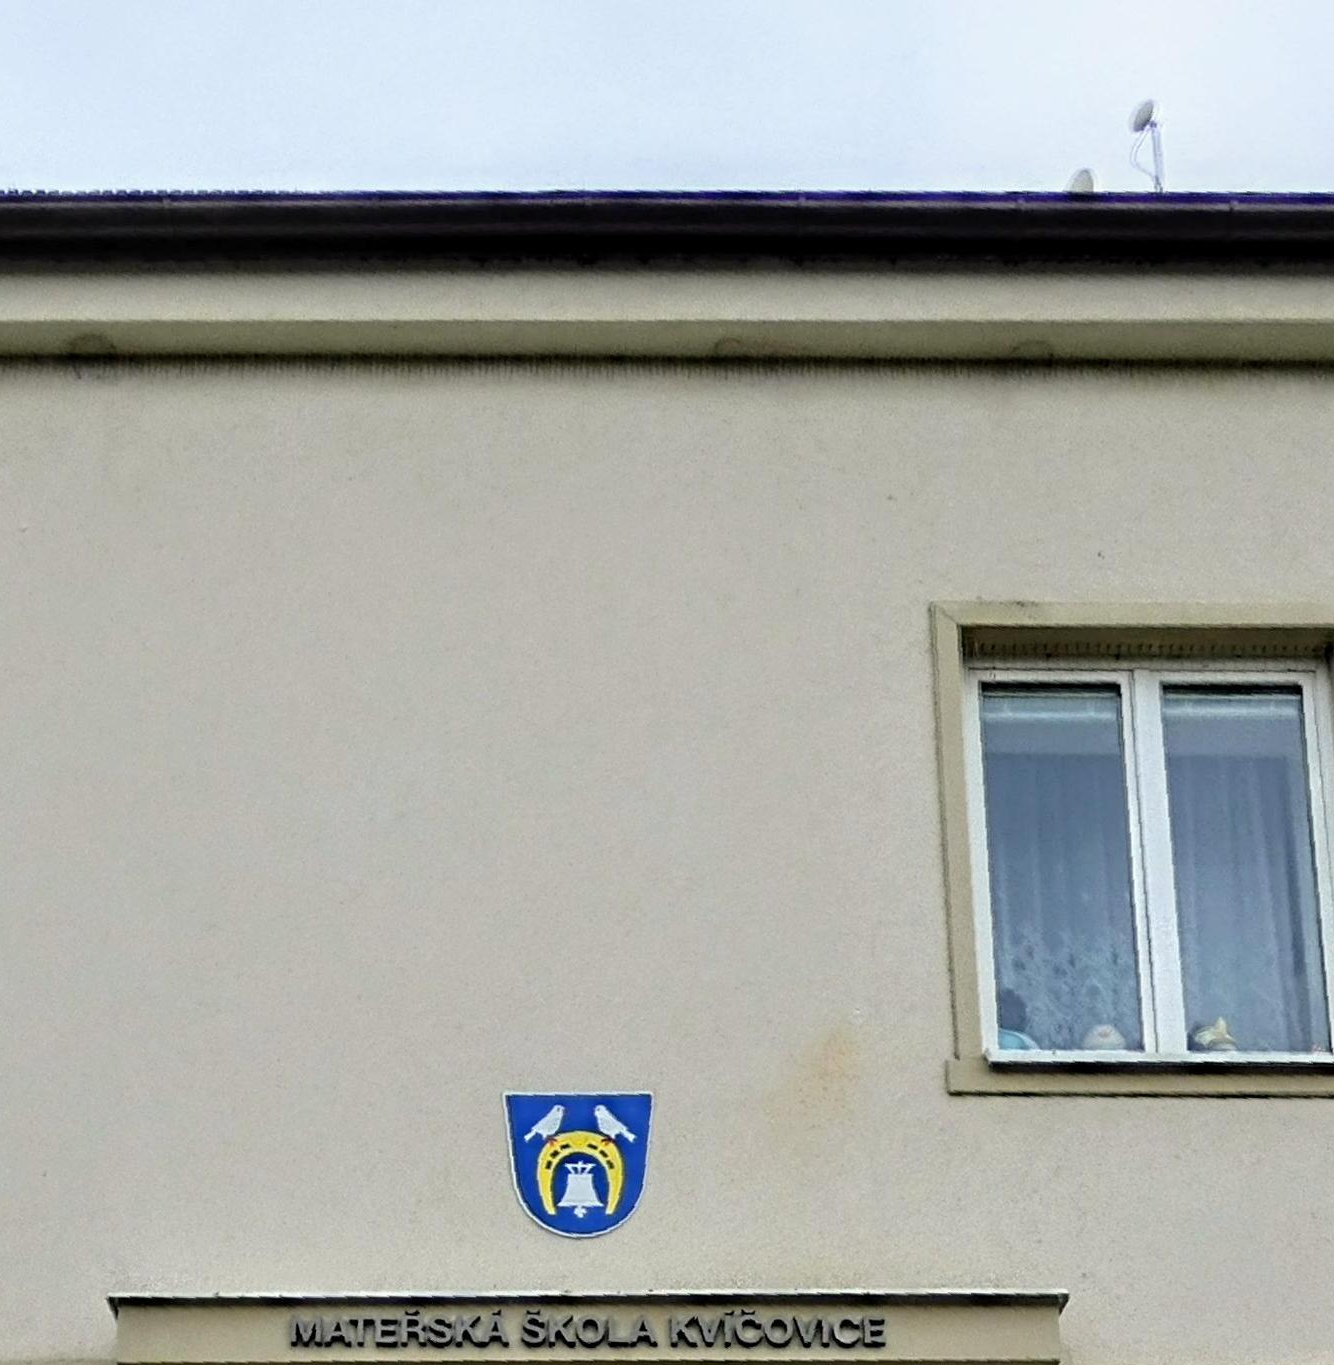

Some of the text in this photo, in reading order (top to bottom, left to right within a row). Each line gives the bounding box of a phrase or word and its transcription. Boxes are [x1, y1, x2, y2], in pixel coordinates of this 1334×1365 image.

[290, 1309, 887, 1349] MATEŘSKÁ ŠKOLA KVÍČOVICE
